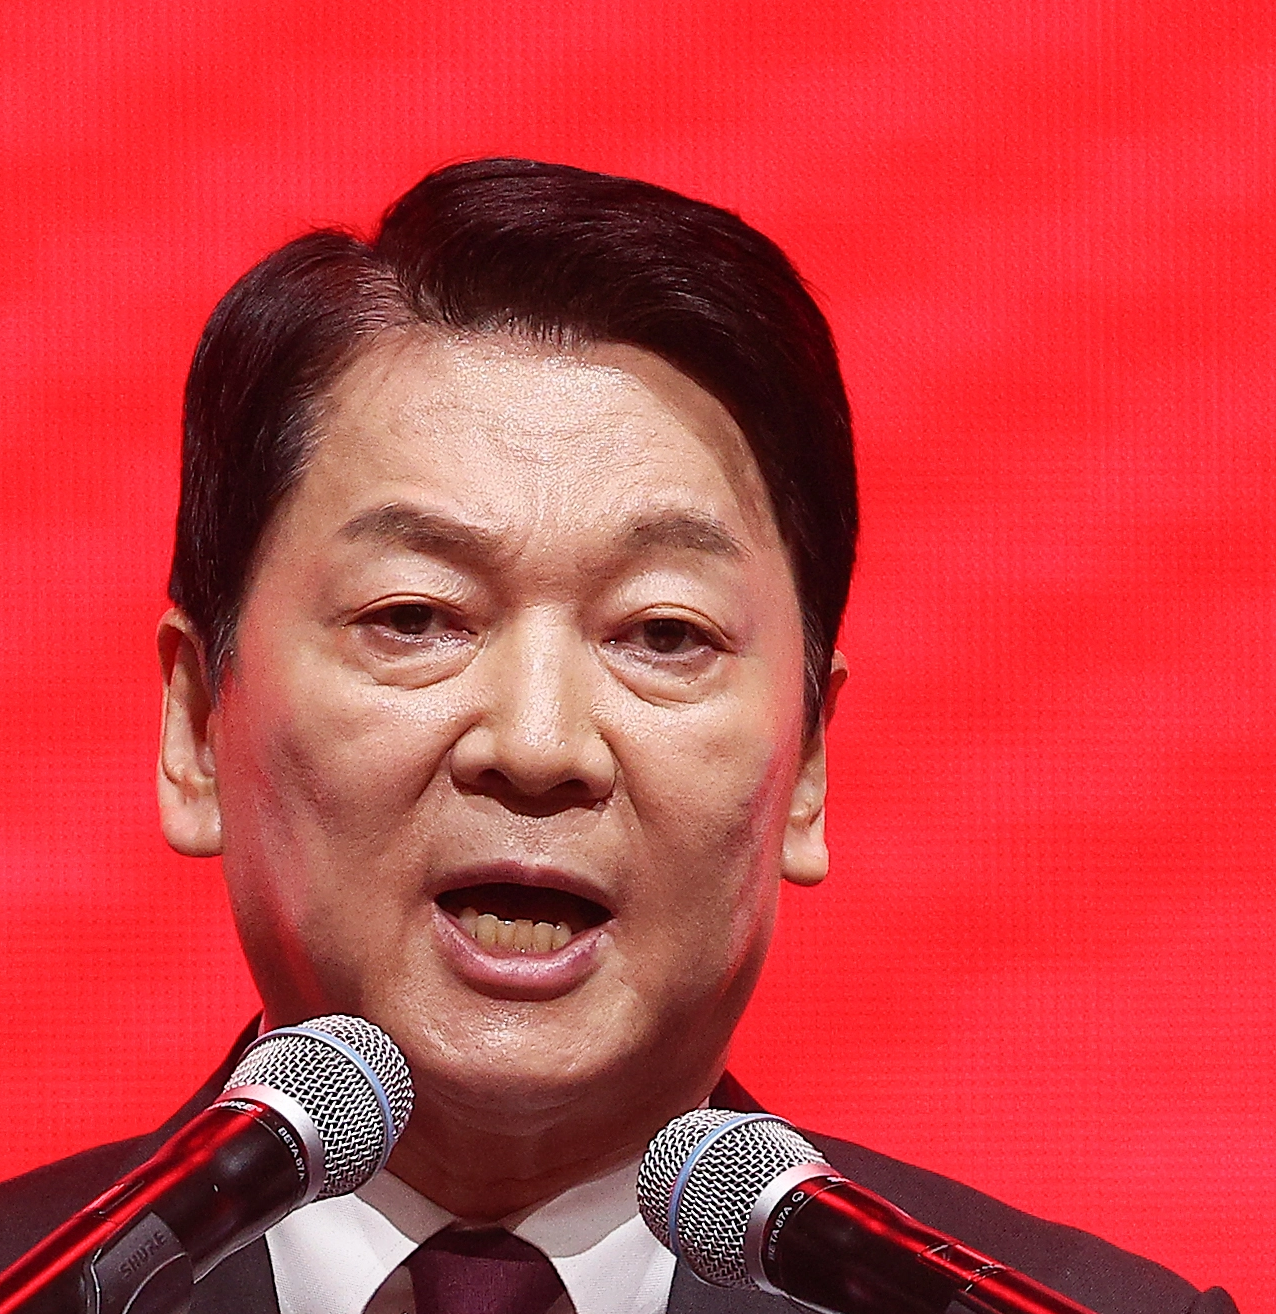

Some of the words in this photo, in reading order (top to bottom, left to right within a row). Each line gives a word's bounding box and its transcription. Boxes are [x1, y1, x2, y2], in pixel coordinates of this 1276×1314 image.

[278, 1127, 299, 1157] BETA
[775, 1206, 793, 1228] 87A
[118, 1230, 167, 1279] SHURE
